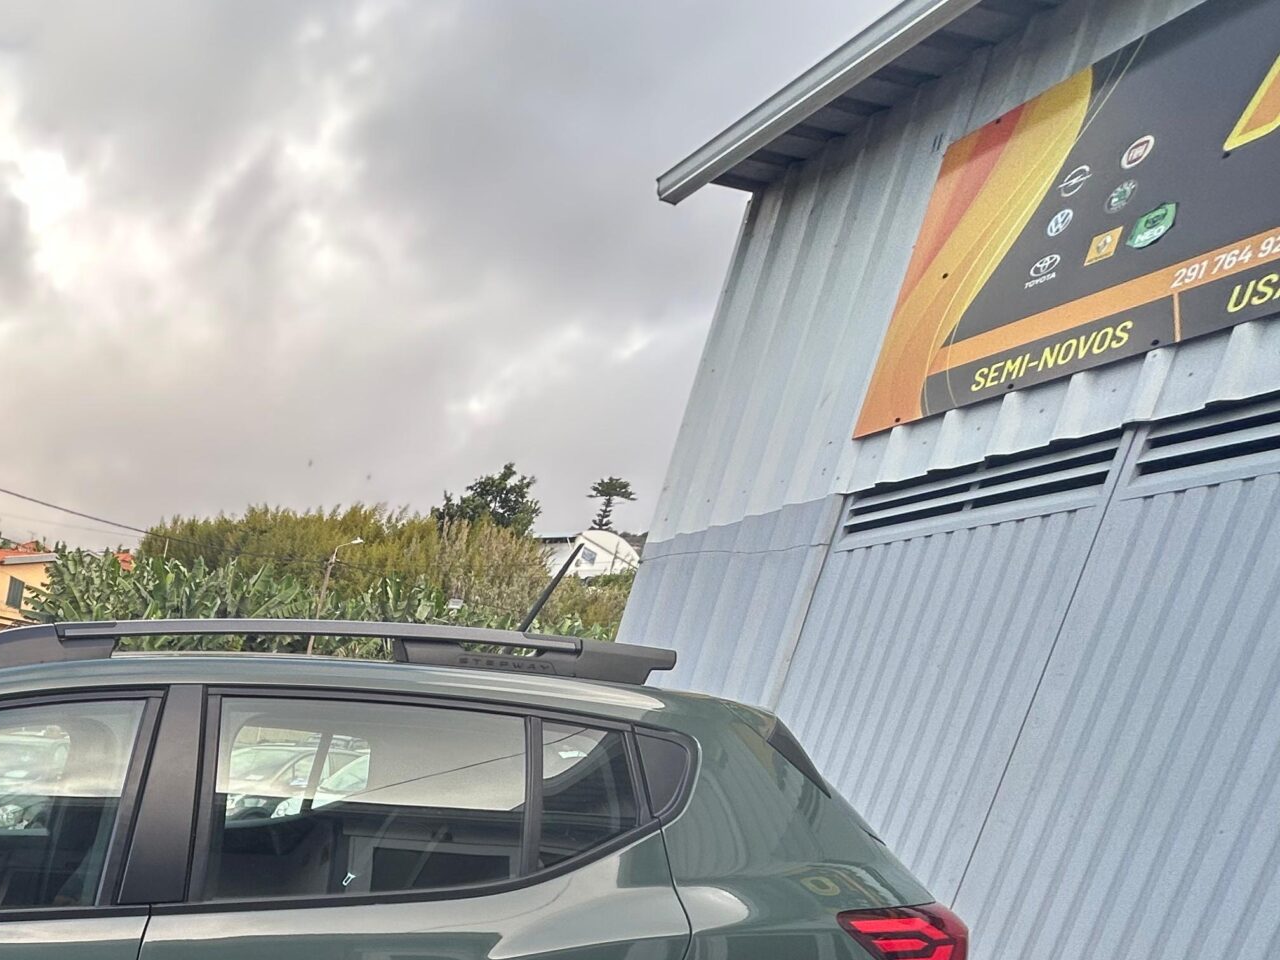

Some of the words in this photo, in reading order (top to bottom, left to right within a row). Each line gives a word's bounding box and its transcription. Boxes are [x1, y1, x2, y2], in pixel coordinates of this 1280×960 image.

[1024, 271, 1056, 289] TOYOTA
[1170, 260, 1208, 288] 291
[1211, 244, 1253, 275] 764
[971, 320, 1133, 392] SEMI-NOVOS
[459, 657, 549, 670] STEPWAY
